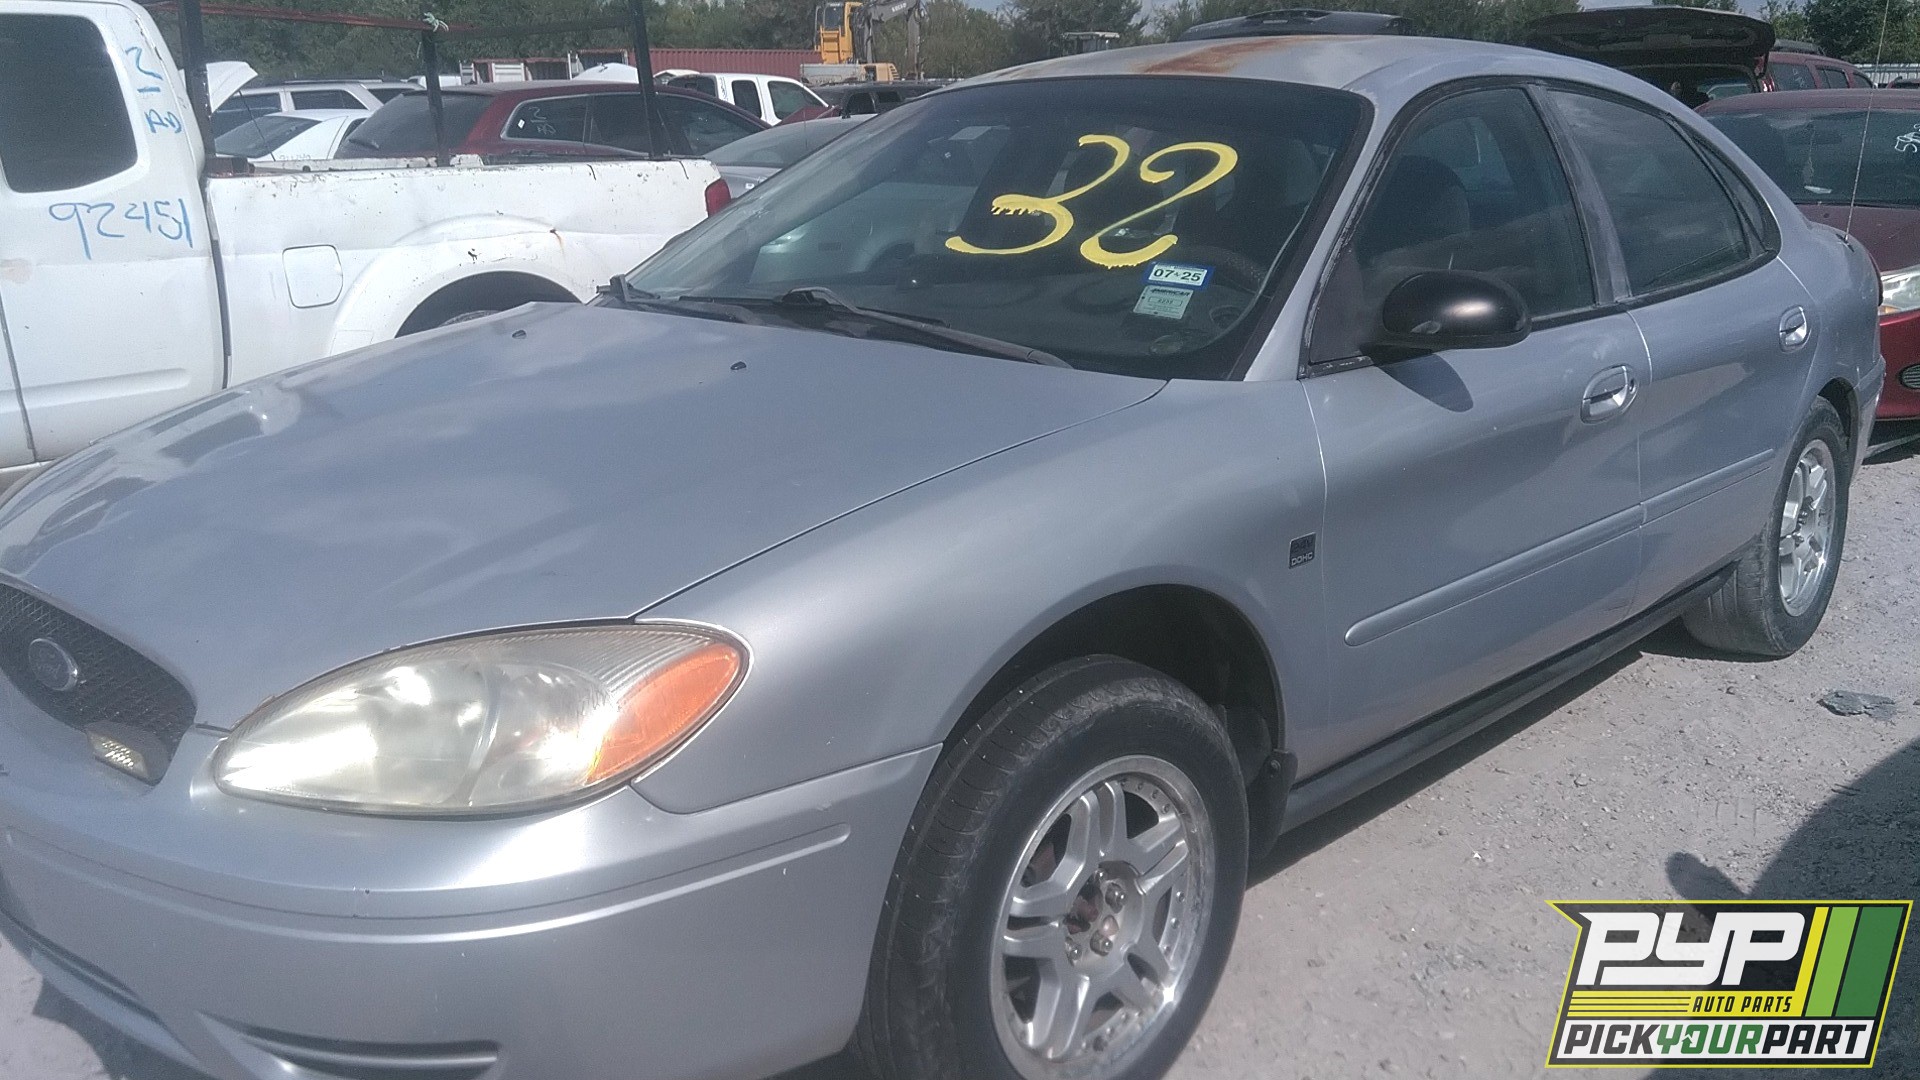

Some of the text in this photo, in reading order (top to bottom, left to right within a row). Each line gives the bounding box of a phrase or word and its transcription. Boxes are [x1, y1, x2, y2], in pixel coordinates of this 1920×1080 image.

[125, 46, 163, 80] 2
[945, 134, 1238, 269] 32
[1153, 268, 1202, 282] 07 25
[1291, 551, 1313, 566] DOHC
